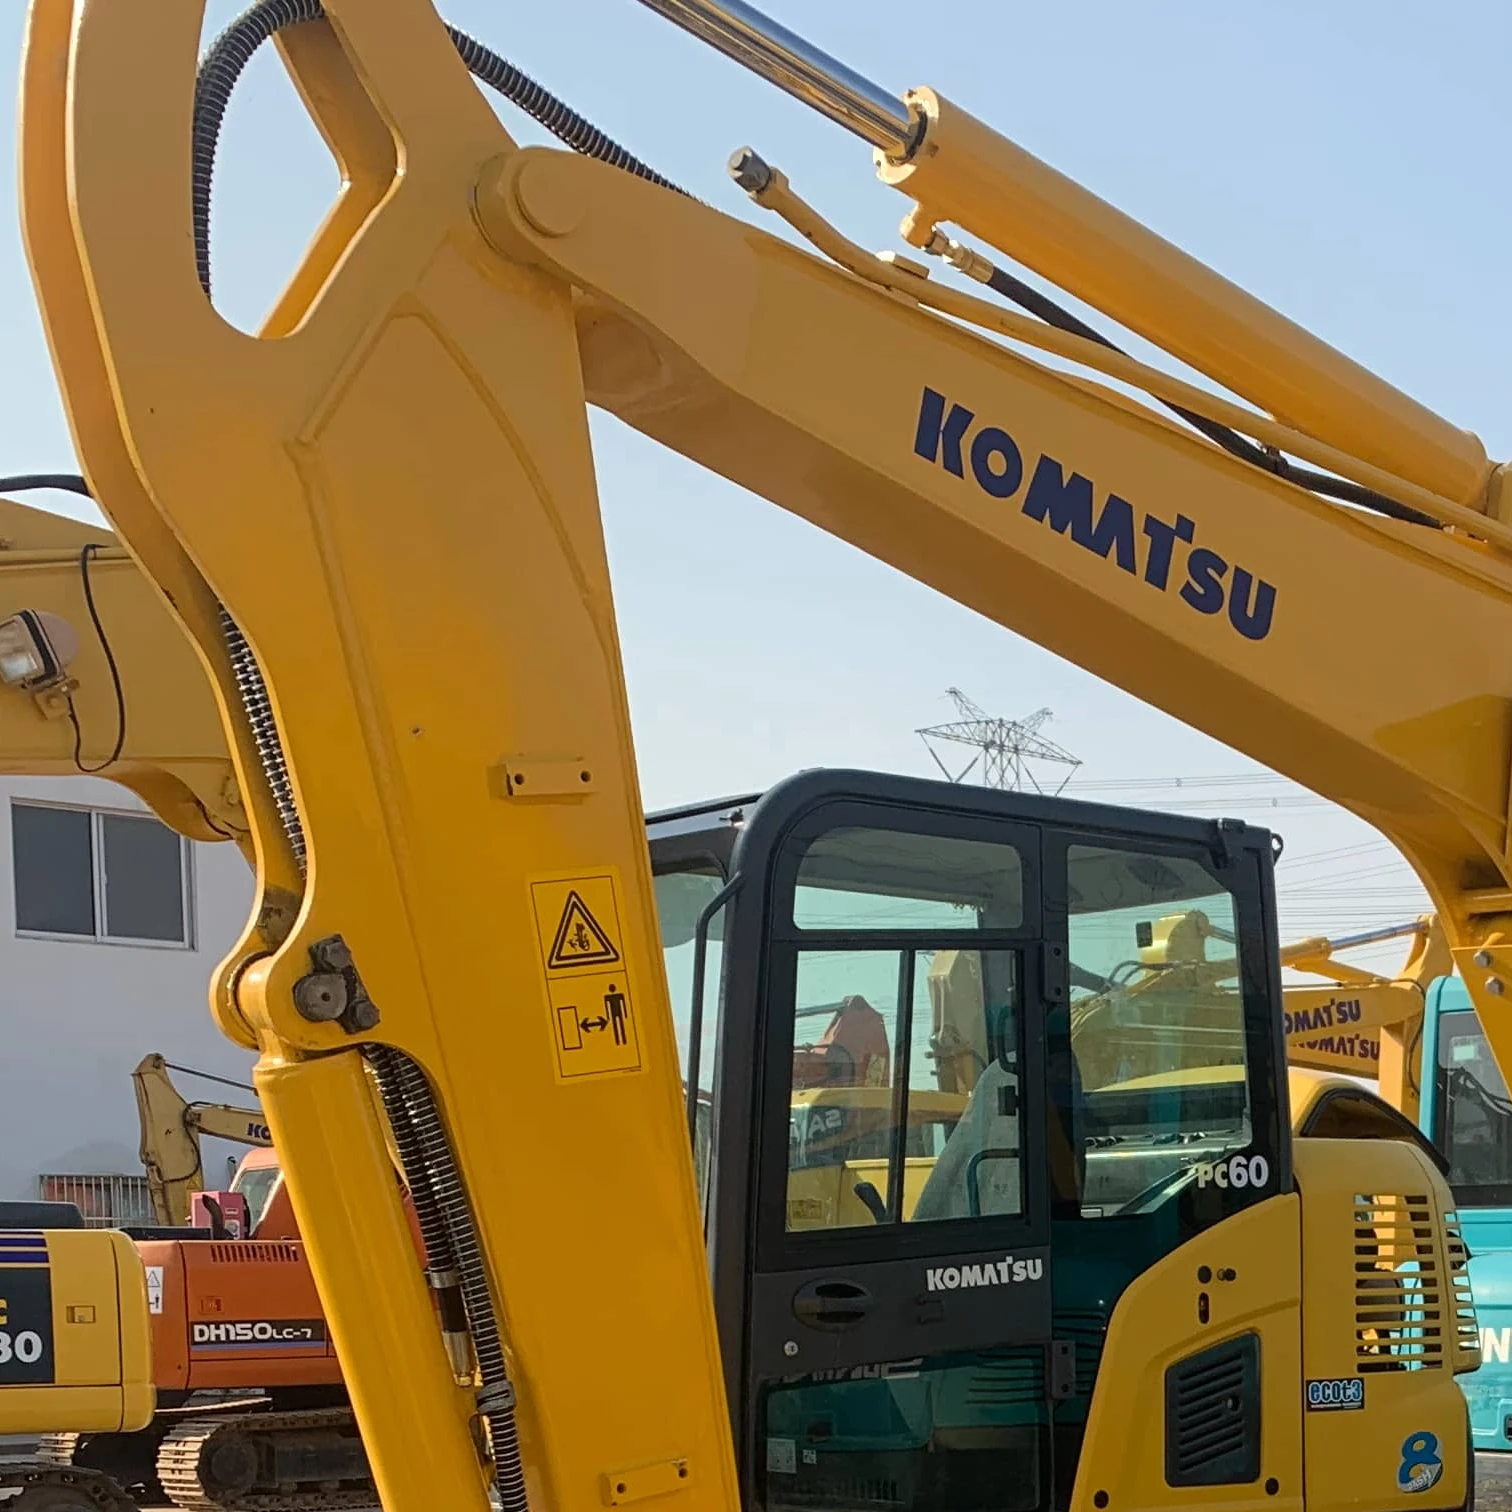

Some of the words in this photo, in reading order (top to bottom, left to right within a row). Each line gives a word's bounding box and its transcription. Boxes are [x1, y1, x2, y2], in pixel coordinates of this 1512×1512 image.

[914, 386, 1277, 641] KOMATSU
[1197, 1155, 1269, 1188] PC60
[926, 1255, 1043, 1291] KOMATSU
